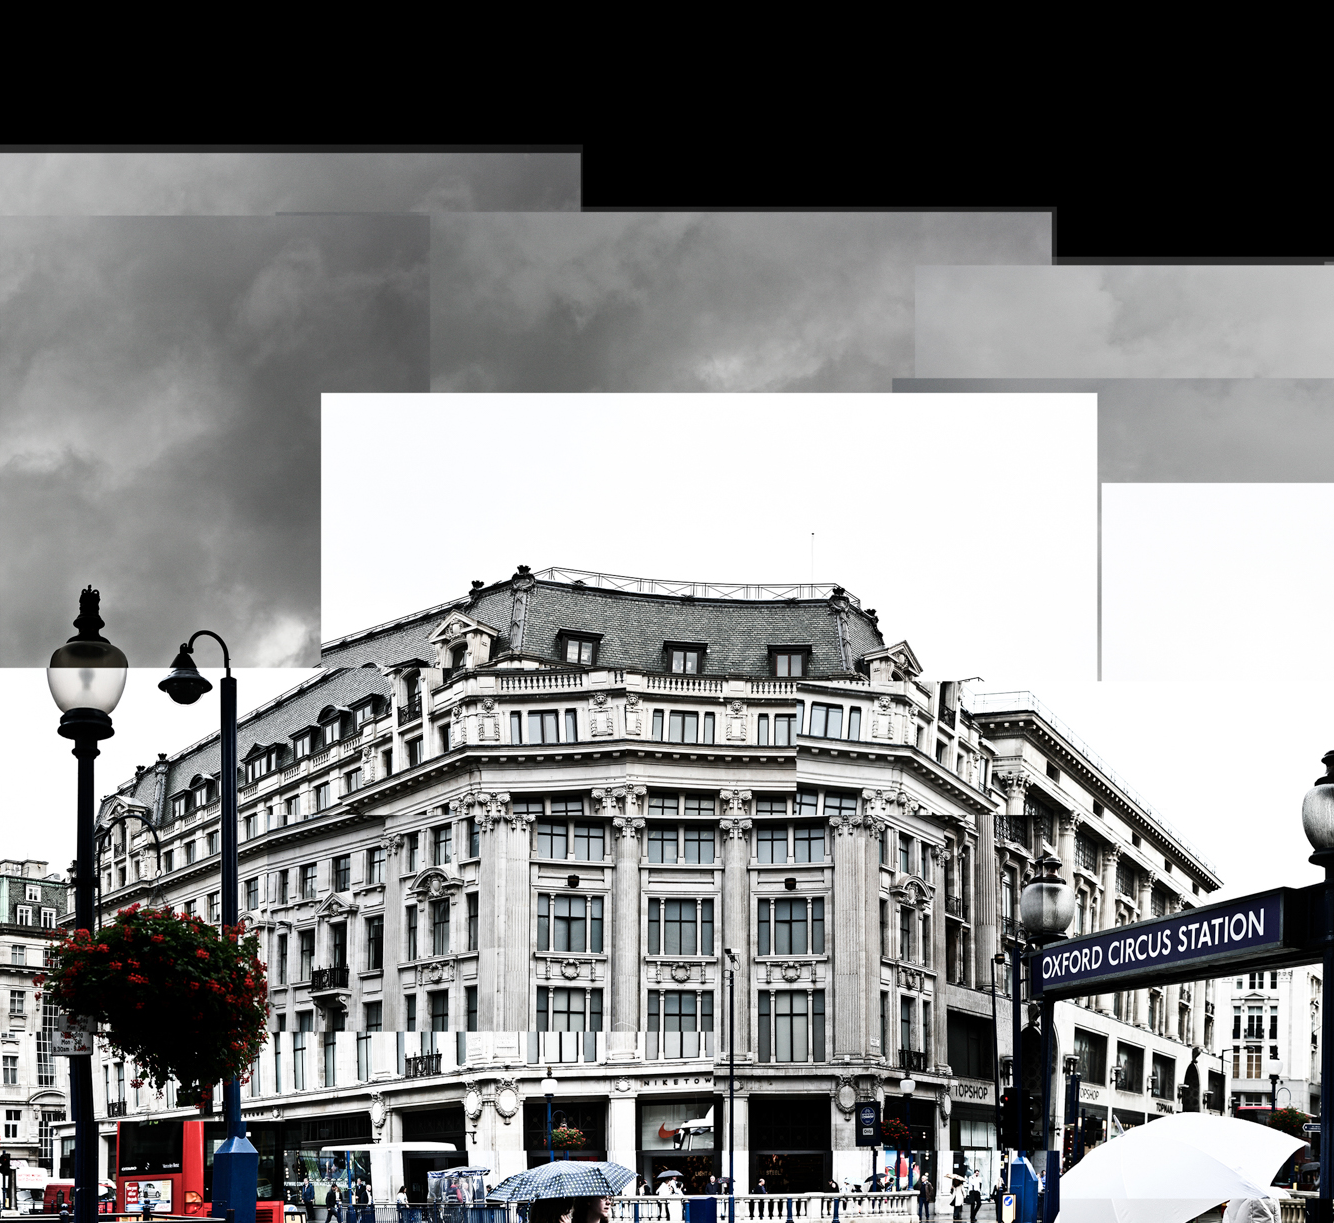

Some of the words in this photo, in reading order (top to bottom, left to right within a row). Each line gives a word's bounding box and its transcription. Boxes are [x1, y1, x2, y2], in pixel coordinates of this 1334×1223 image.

[1042, 945, 1103, 980] OXFORD
[1107, 929, 1172, 966] CIRCUS
[1177, 908, 1265, 953] STATION
[955, 1084, 989, 1100] TOPSHOP
[1078, 1087, 1100, 1100] OPSHOP
